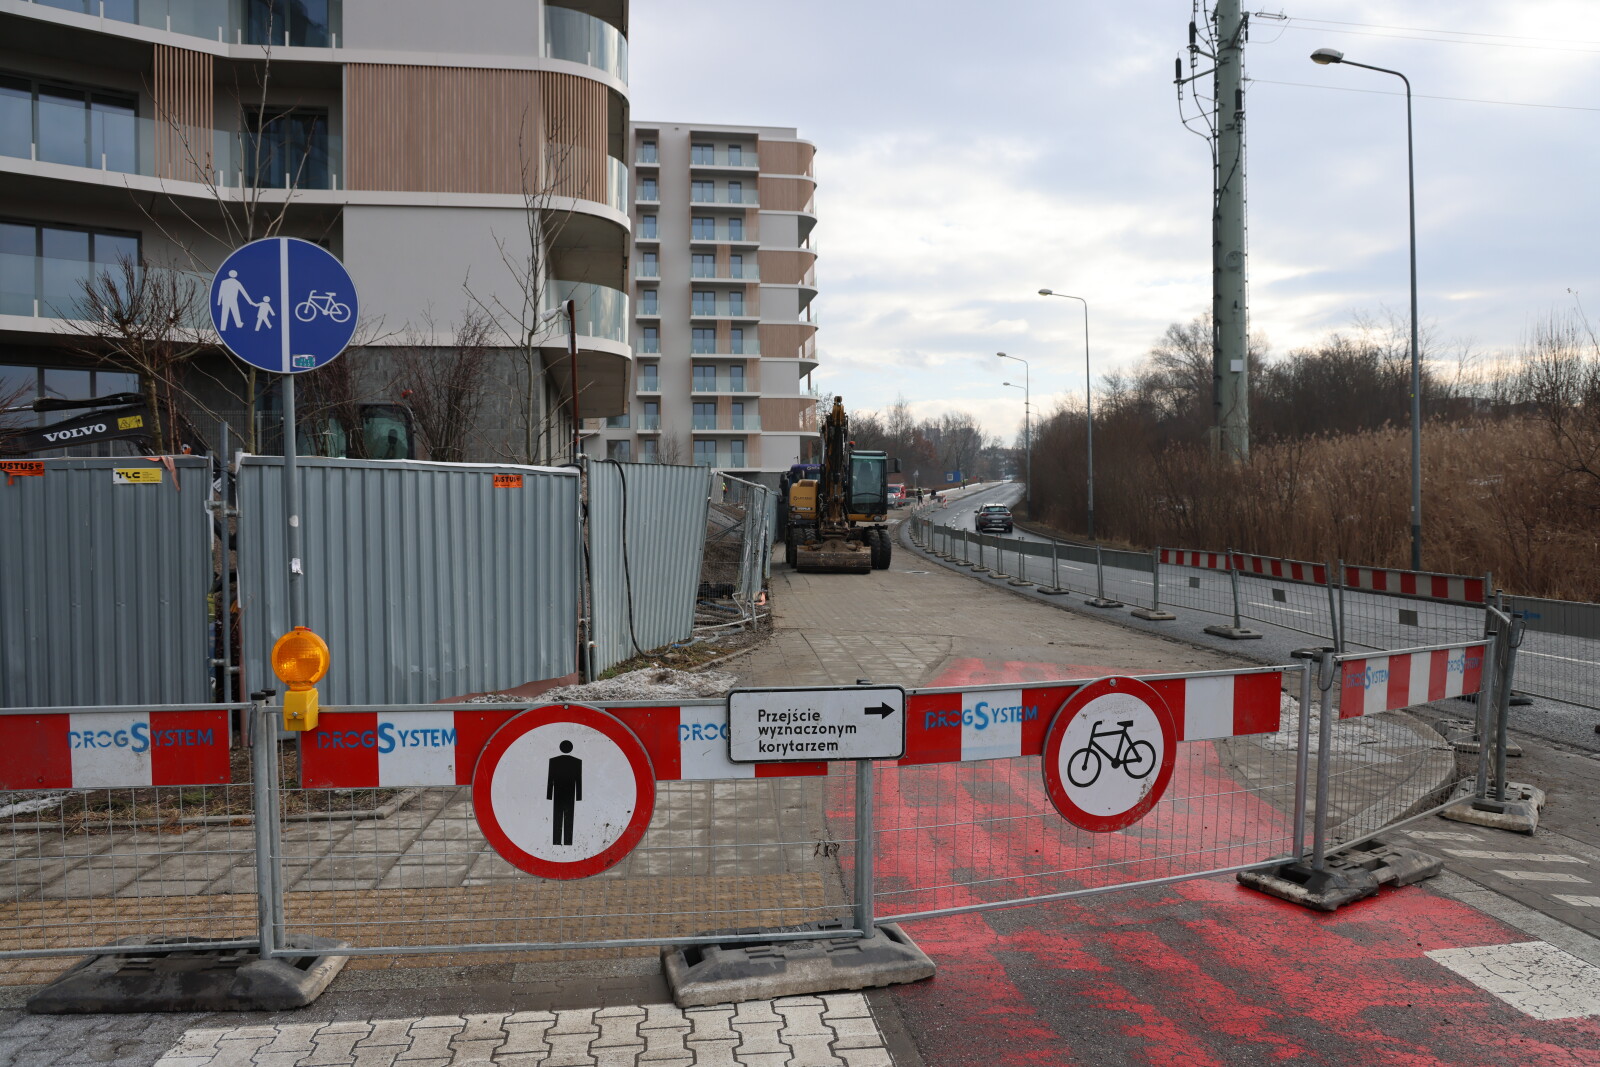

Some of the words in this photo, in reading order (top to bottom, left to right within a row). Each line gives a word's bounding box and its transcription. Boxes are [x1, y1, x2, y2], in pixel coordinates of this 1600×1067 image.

[43, 423, 107, 442] VOLVO
[0, 462, 34, 470] USTUS
[757, 708, 822, 725] Przejście
[757, 723, 858, 739] wyznaczonym
[757, 739, 840, 756] korytarzem
